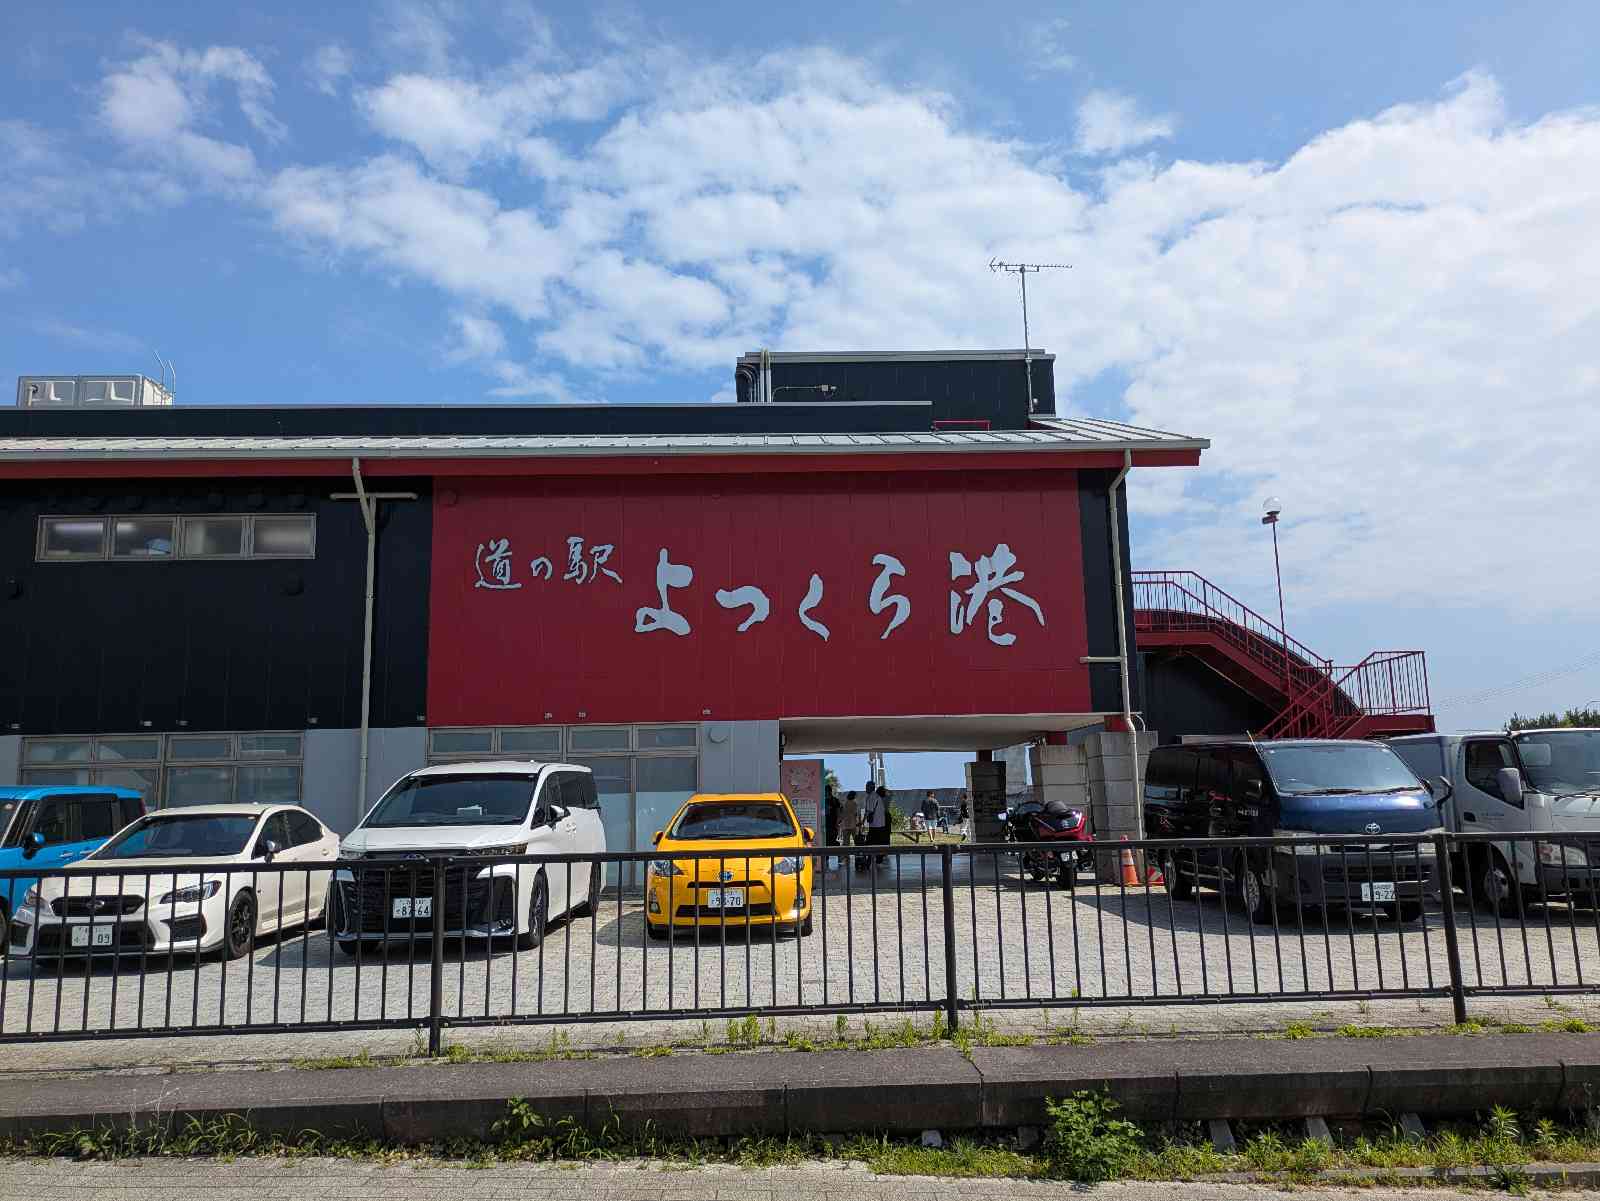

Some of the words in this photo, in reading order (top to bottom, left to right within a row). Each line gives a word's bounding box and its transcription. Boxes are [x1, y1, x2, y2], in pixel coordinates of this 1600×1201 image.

[474, 536, 624, 590] 道の駅
[634, 543, 1045, 646] よつくら港
